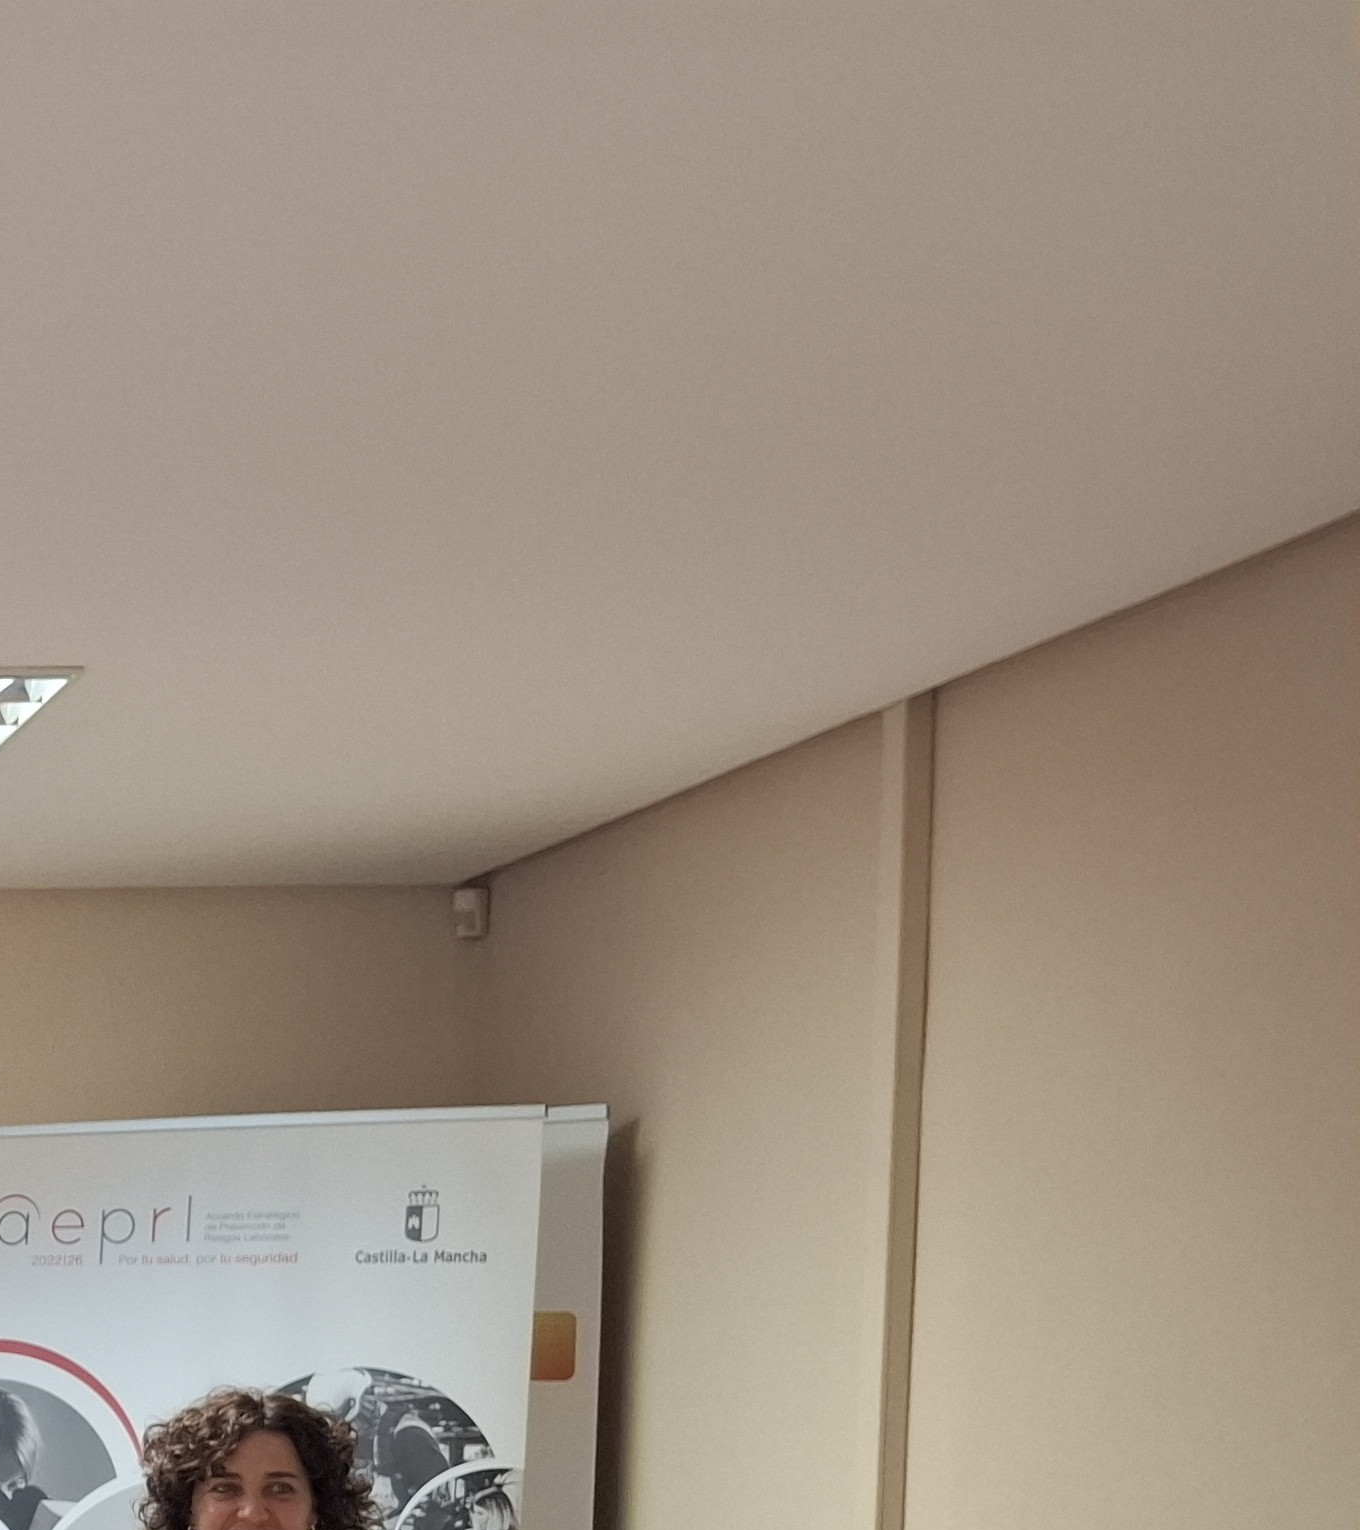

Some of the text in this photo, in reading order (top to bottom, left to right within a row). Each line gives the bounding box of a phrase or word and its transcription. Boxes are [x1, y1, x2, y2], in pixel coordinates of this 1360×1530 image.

[118, 1252, 137, 1266] Por
[141, 1253, 153, 1265] tu
[195, 1254, 216, 1266] por
[220, 1253, 232, 1265] tu
[234, 1250, 298, 1267] seguridad
[354, 1249, 488, 1264] Castilla-La Mancha
